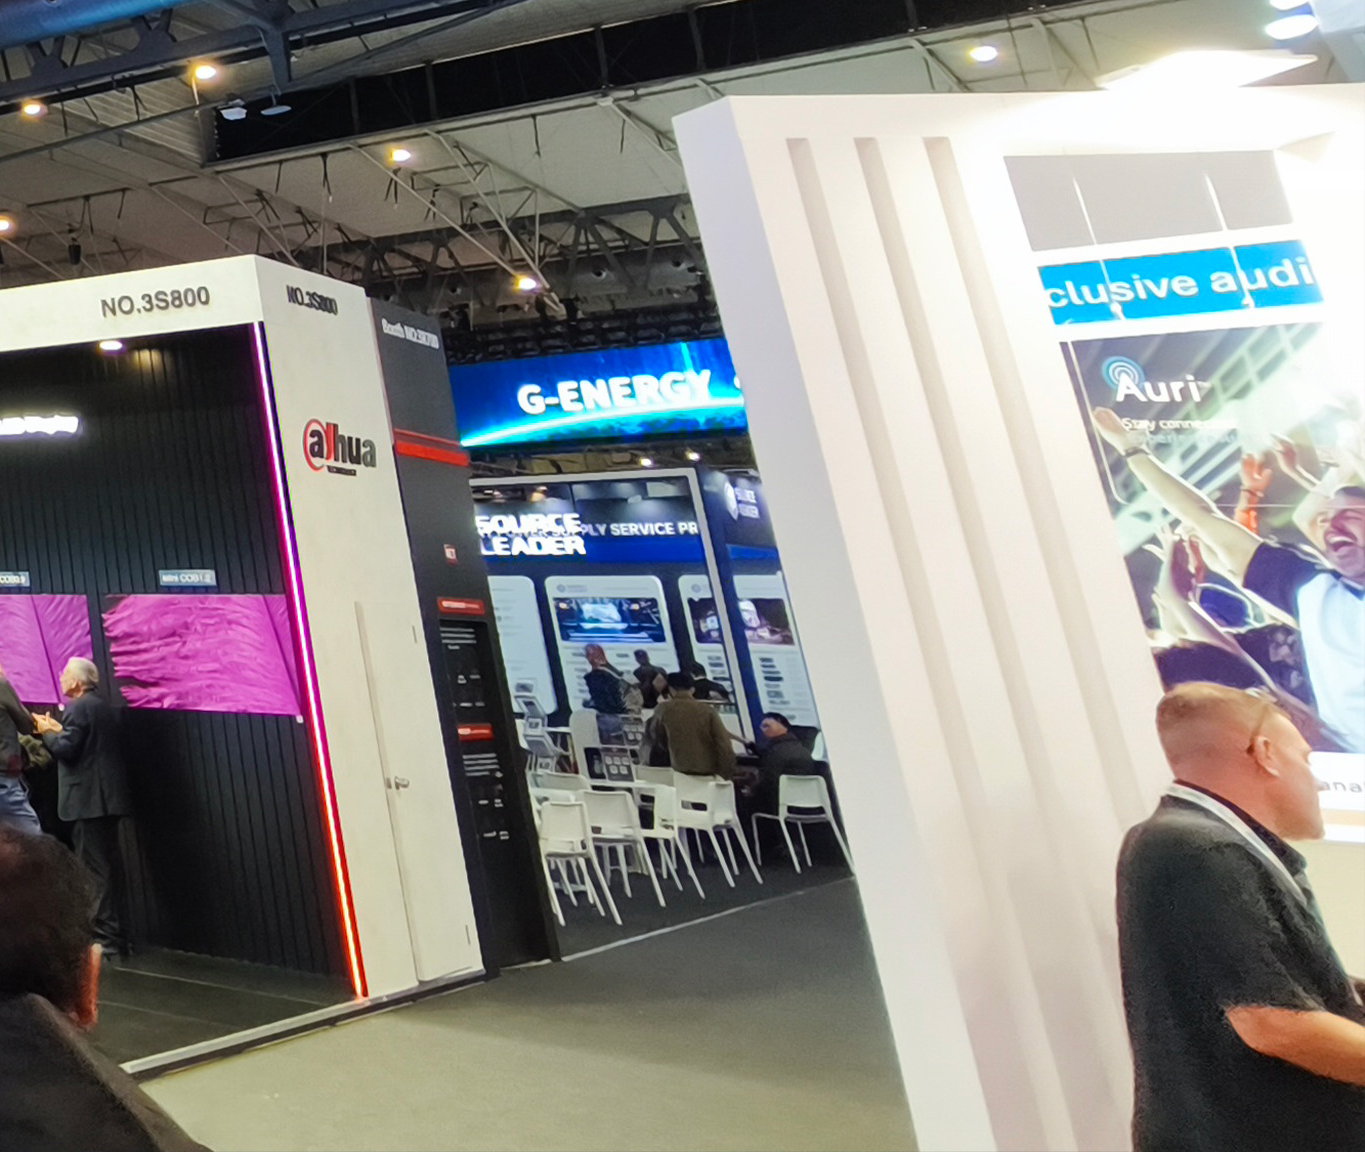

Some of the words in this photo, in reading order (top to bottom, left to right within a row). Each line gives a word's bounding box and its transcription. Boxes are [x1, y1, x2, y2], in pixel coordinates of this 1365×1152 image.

[100, 286, 211, 318] NO.3S800
[517, 369, 711, 415] G-ENERGY
[1116, 372, 1202, 402] Auri
[610, 522, 675, 536] SERVICE
[480, 536, 587, 555] LEADER
